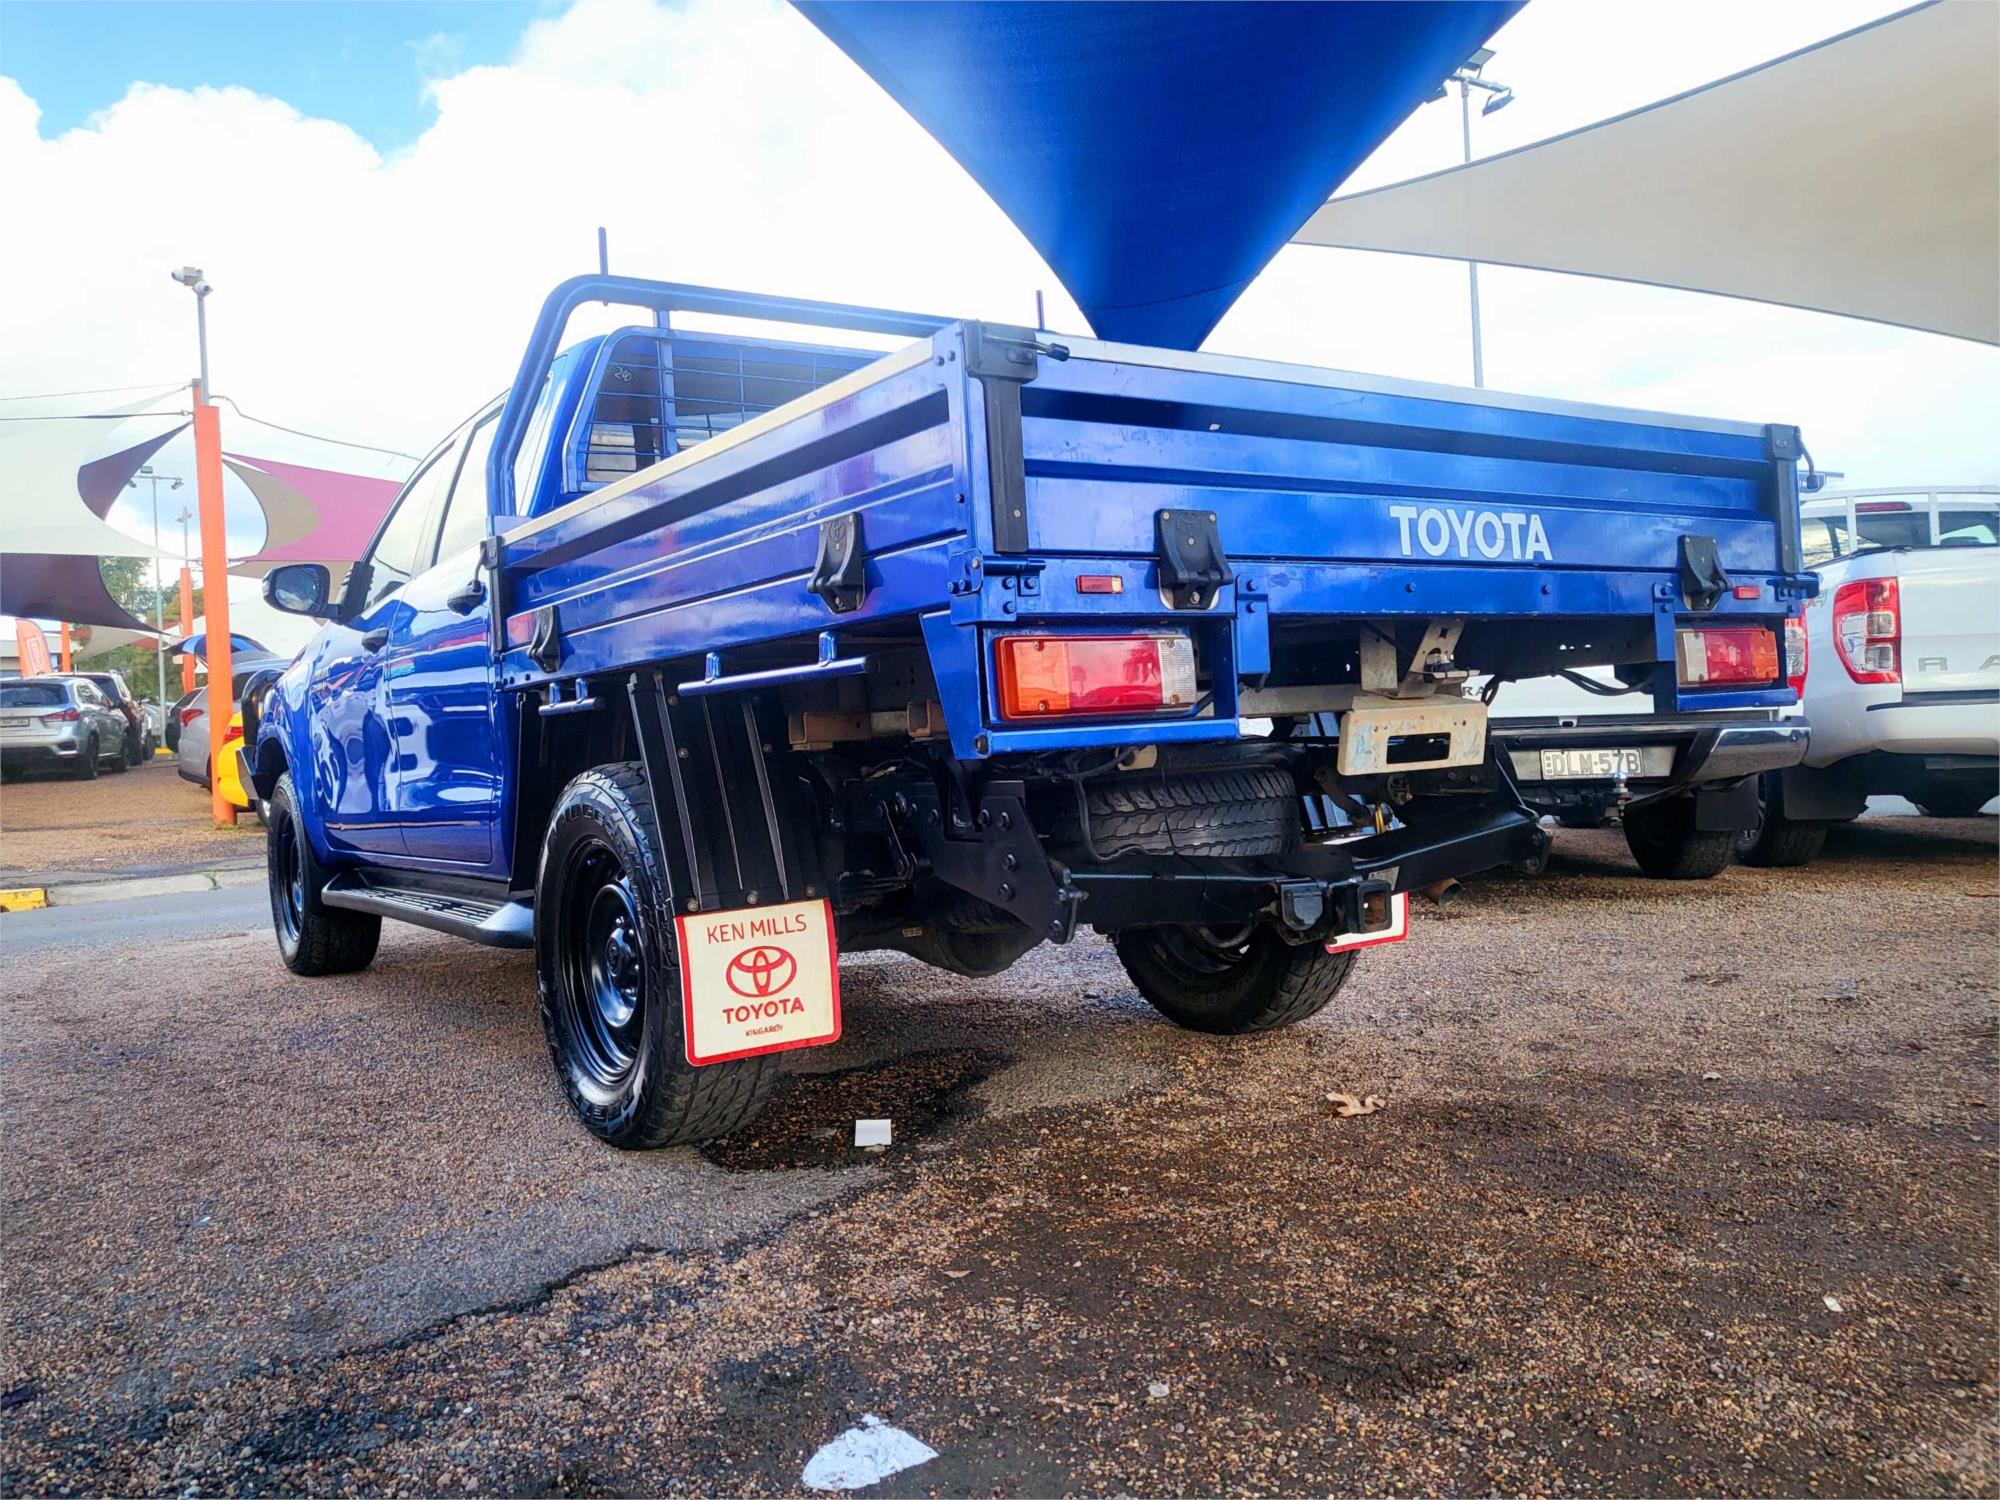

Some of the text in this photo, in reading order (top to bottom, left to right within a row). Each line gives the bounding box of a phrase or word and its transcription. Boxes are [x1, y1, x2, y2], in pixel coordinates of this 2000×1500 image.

[1389, 505, 1553, 560] TOYOTA
[707, 914, 807, 944] KEN MILLS
[722, 997, 805, 1024] TOYOTA
